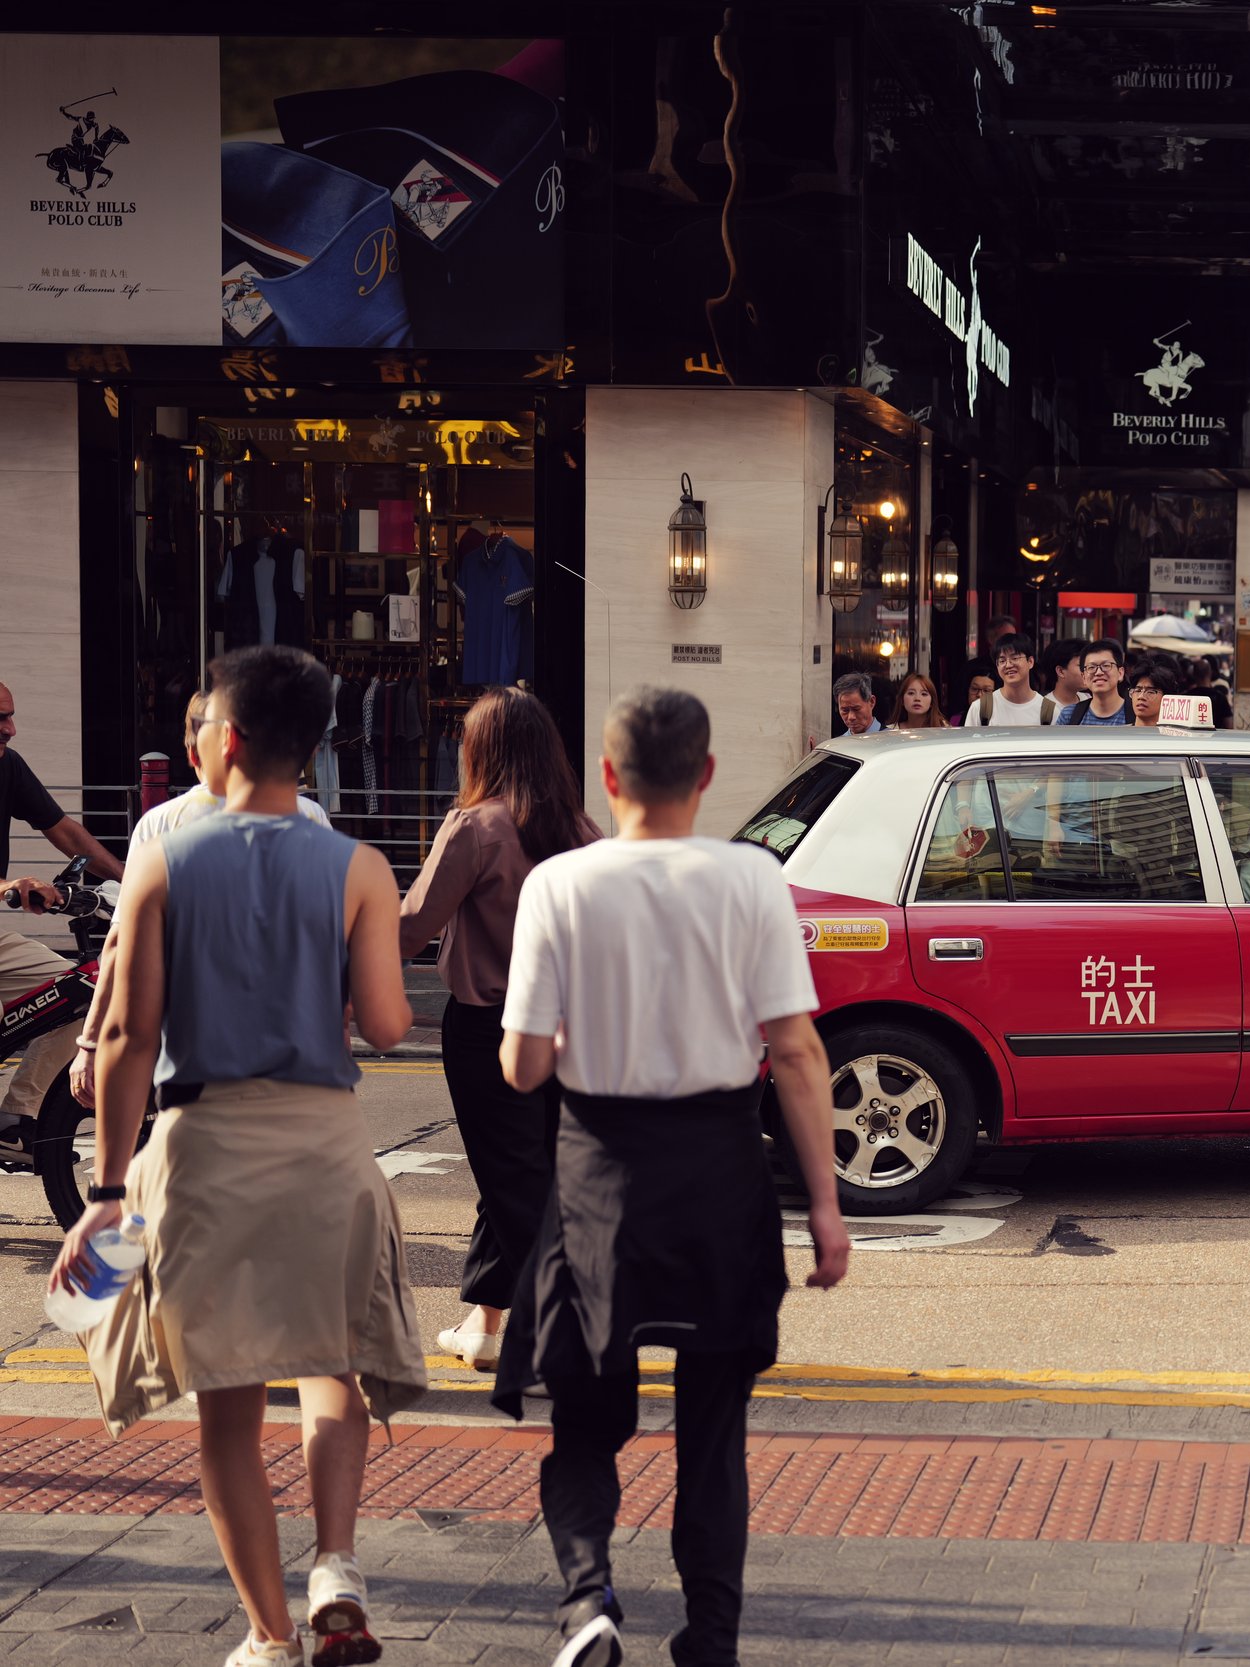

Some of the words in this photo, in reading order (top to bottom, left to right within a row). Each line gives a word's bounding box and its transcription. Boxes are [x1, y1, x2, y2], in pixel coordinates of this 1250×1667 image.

[30, 200, 91, 213] BEVERLY
[96, 201, 137, 214] HILLS
[48, 214, 84, 226] POLO
[88, 214, 123, 227] CLUB
[27, 282, 70, 298] Heritage
[73, 284, 115, 293] Becomes
[120, 281, 142, 300] Life
[1112, 412, 1178, 429] BEVERLY
[1180, 413, 1226, 430] HILLS
[226, 427, 299, 442] BEVERLY
[416, 429, 460, 444] POLO
[463, 430, 507, 444] CLUB
[1127, 430, 1168, 446] POLO
[1170, 431, 1210, 447] CLUB
[1162, 698, 1191, 721] TAXI
[1197, 703, 1208, 722] 的士
[1081, 955, 1156, 988] 的士
[1081, 990, 1156, 1025] TAXI
